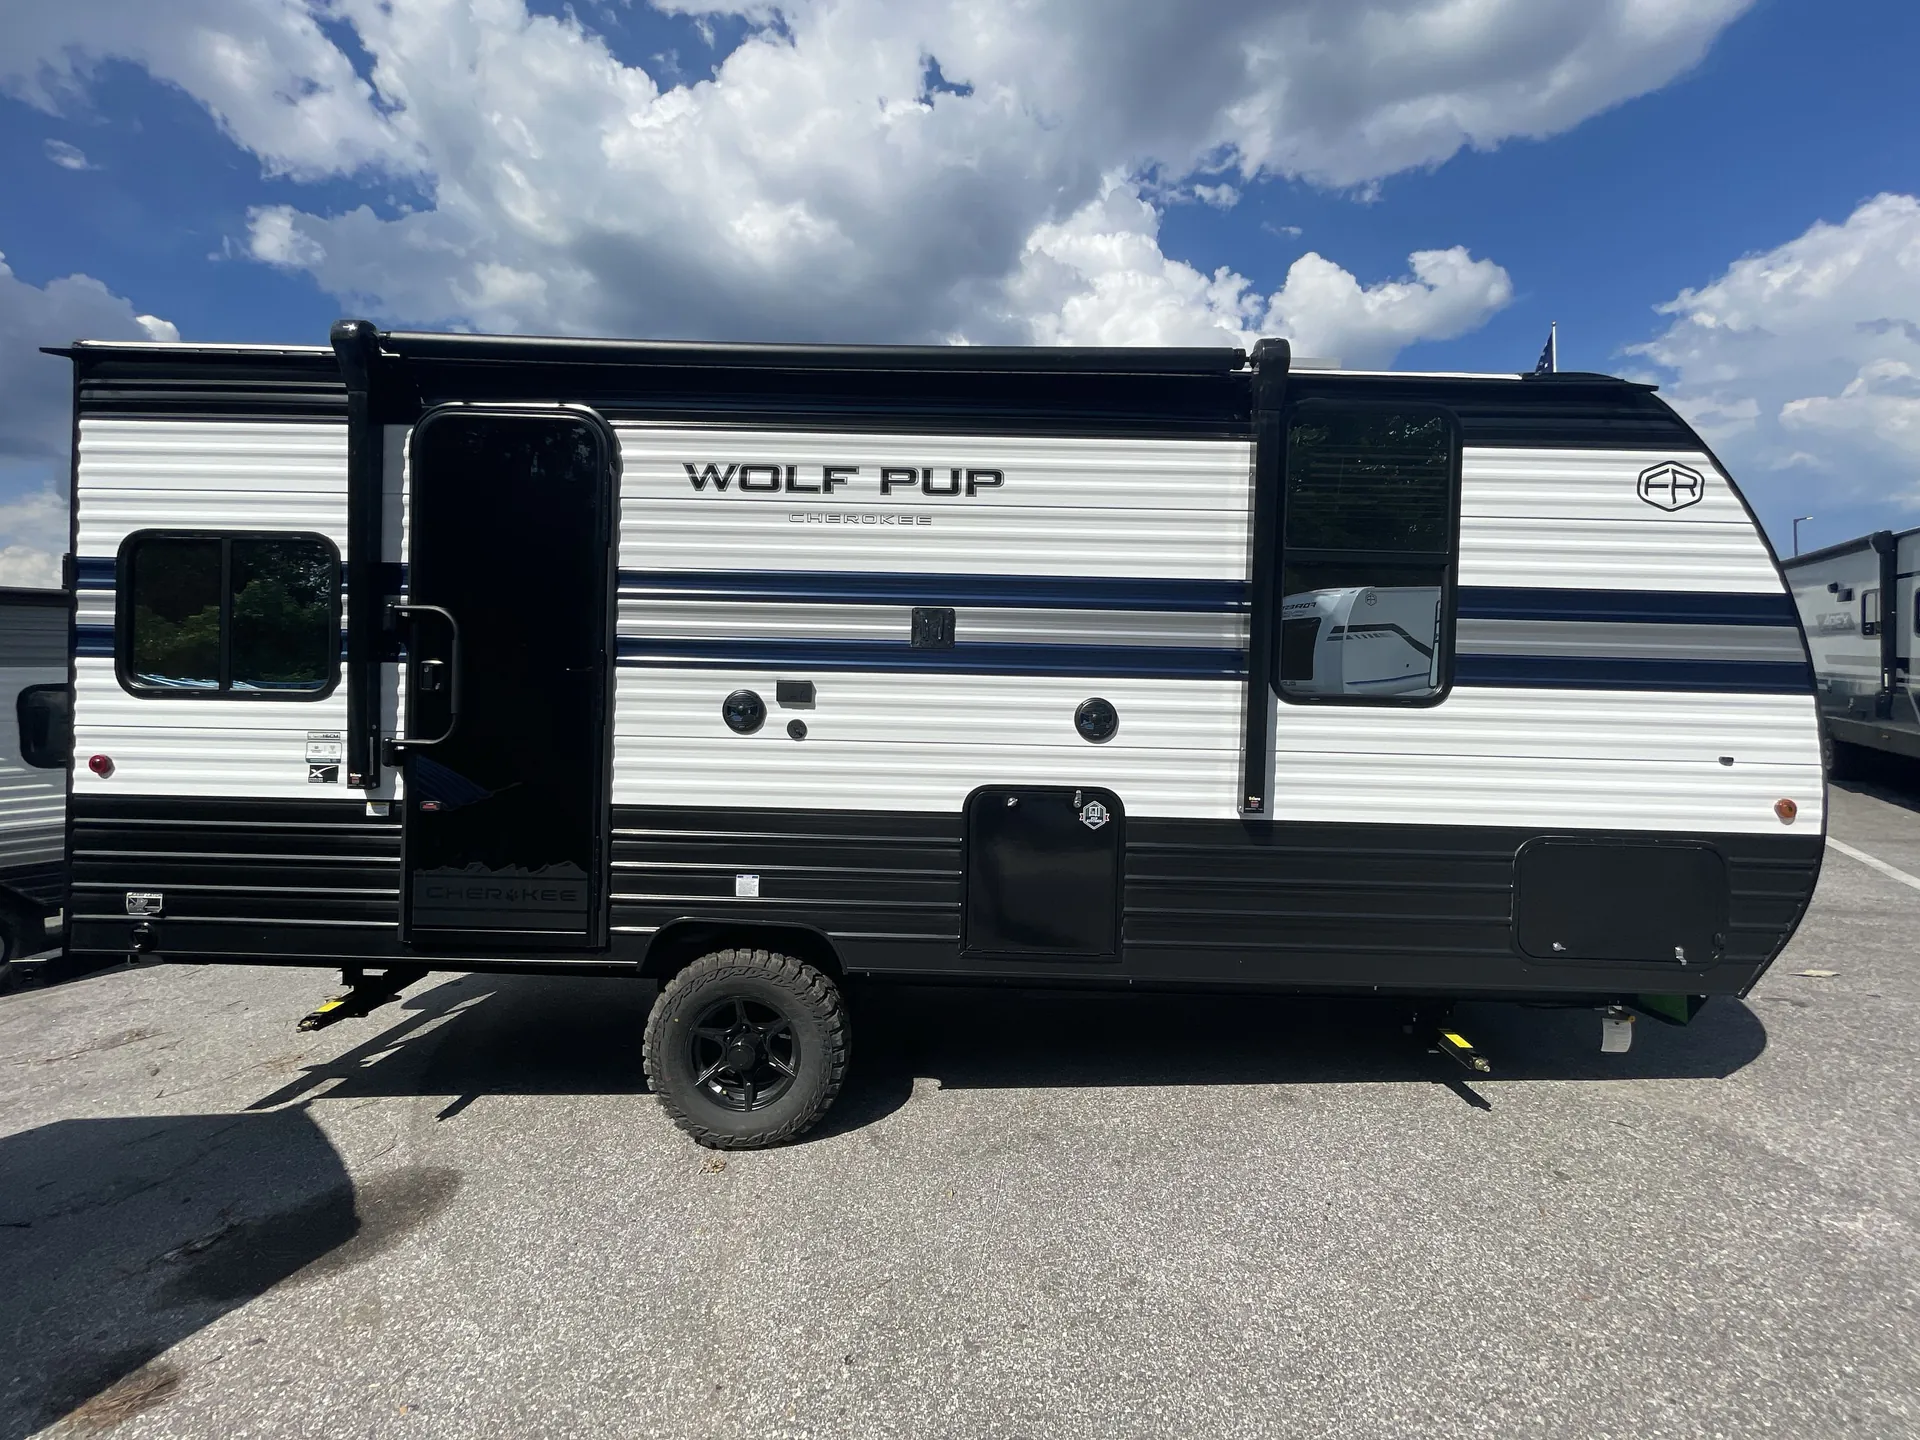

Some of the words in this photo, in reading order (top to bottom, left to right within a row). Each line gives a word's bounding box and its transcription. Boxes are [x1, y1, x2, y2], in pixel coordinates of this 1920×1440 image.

[682, 462, 860, 494] WOLF
[879, 466, 1004, 497] PUP
[788, 512, 932, 526] CHEROKEE
